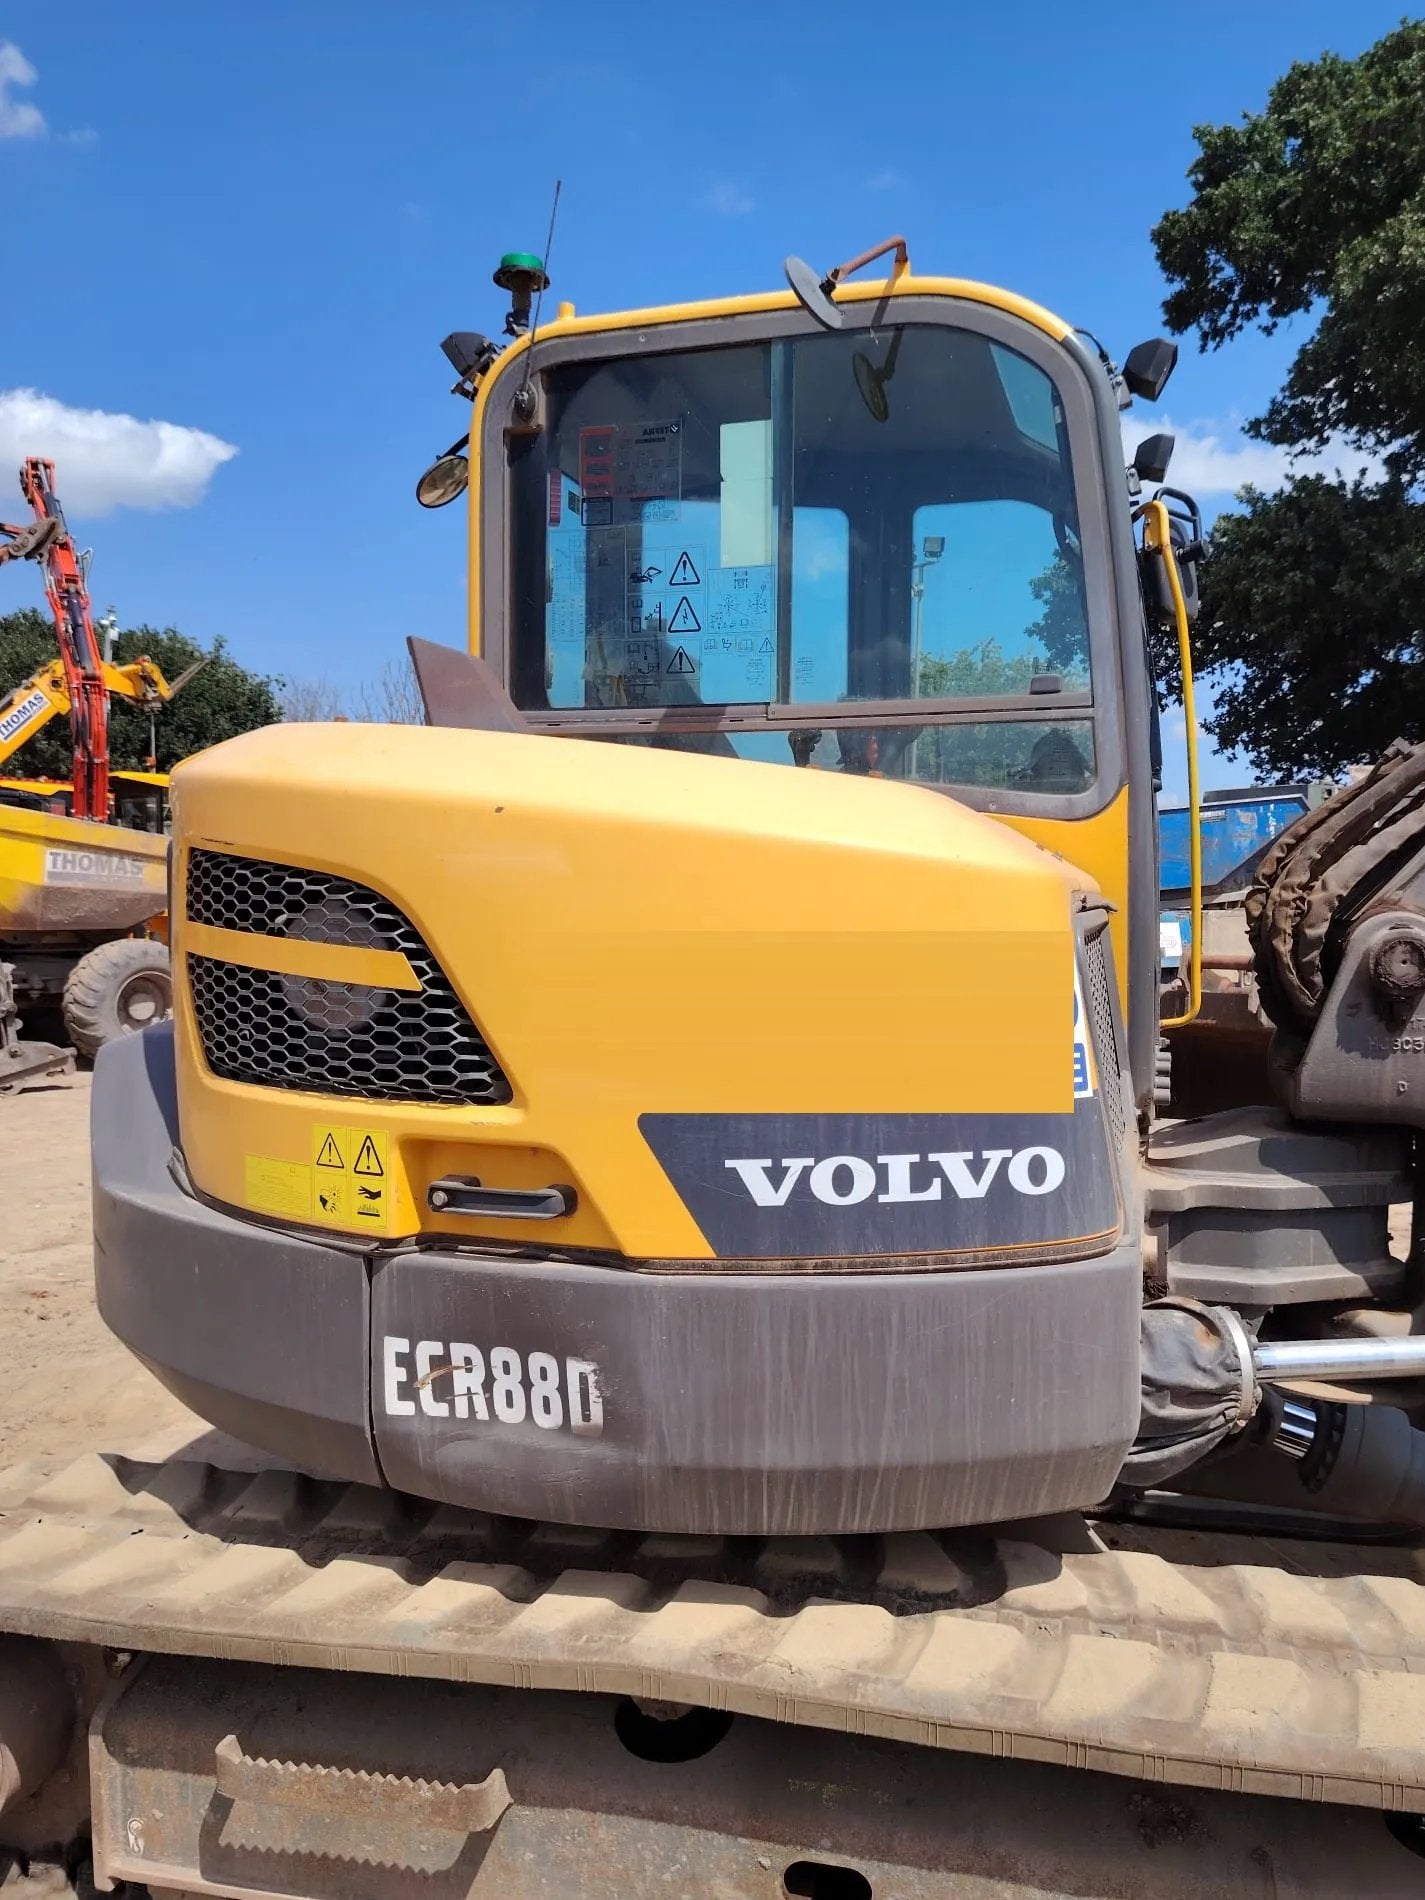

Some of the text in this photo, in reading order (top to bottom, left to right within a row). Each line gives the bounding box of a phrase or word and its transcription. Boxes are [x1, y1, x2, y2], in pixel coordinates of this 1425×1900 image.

[0, 693, 44, 737] THOMAS
[49, 852, 143, 877] THOMAS
[725, 1146, 1066, 1207] VOLVO
[384, 1336, 604, 1438] ECR88D
